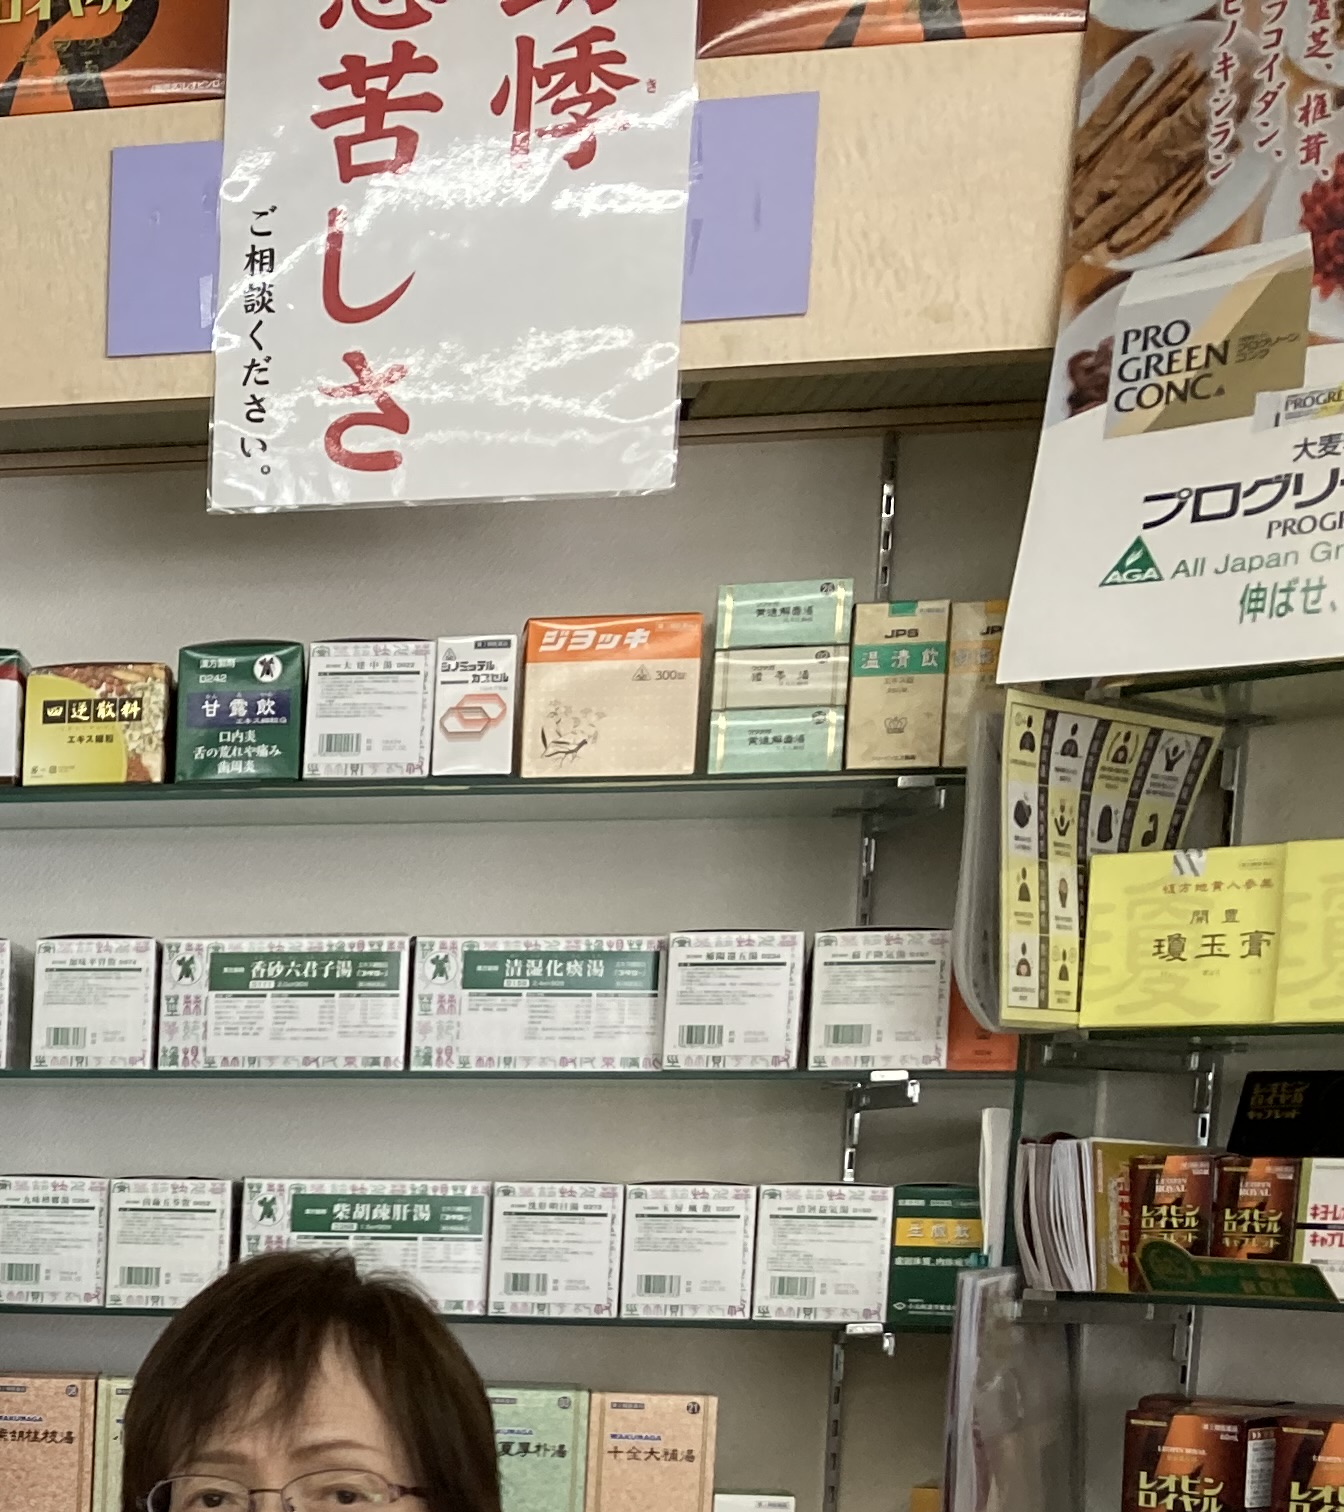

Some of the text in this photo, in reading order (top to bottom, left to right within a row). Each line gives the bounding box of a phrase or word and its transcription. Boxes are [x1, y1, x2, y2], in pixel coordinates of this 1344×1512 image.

[490, 0, 640, 170] 悸
[239, 205, 277, 478] ご相談ください。
[1121, 319, 1191, 355] PRO
[1118, 339, 1230, 383] GREEN
[1142, 467, 1344, 530] プログリ
[1103, 568, 1159, 583] AGA
[1170, 557, 1205, 580] All
[1214, 547, 1299, 575] Japan
[1239, 576, 1337, 624] 伸ばせ、
[45, 702, 142, 721] 四逆散料
[201, 698, 276, 718] 甘露飲
[218, 730, 256, 743] 口内炎
[250, 959, 353, 980] 香砂六君子湯
[607, 1445, 696, 1464] 十全大補湯
[1139, 1471, 1224, 1497] レオピン
